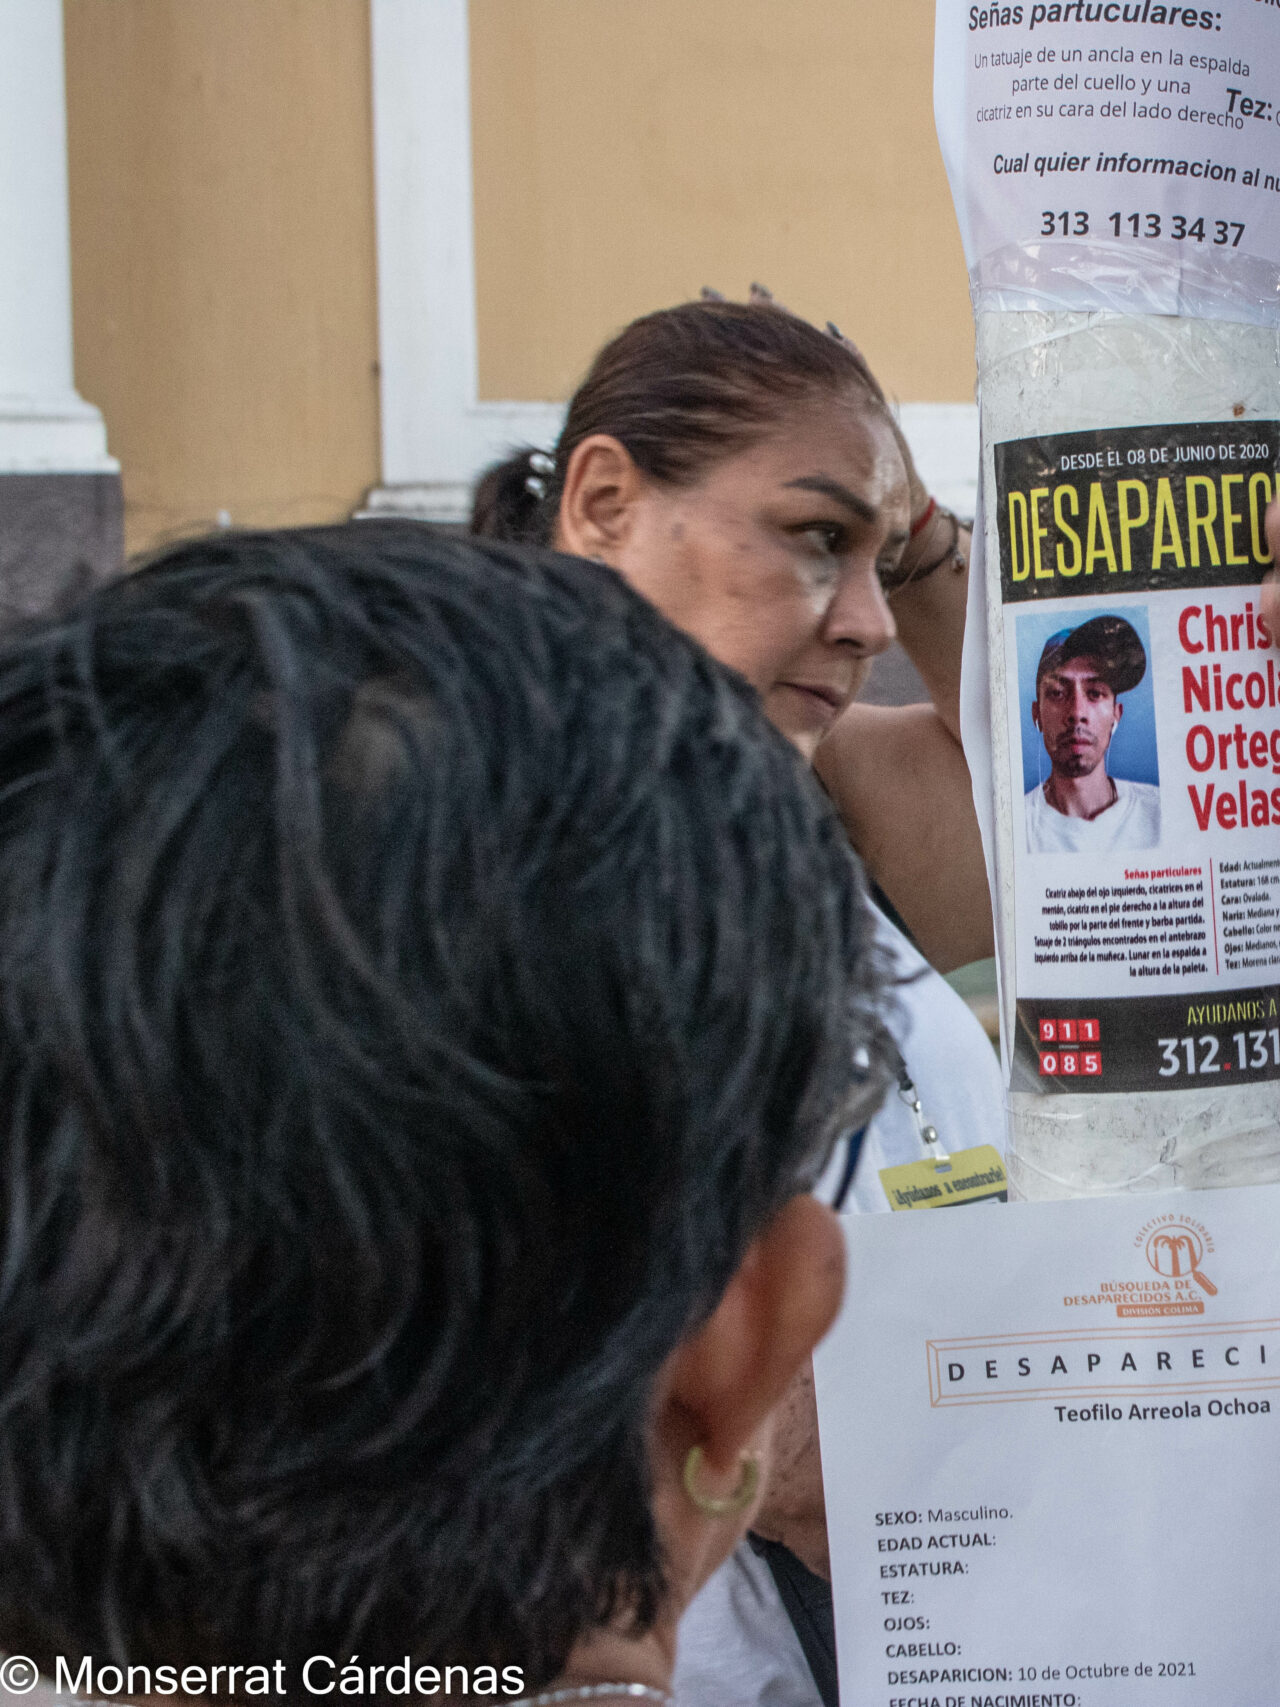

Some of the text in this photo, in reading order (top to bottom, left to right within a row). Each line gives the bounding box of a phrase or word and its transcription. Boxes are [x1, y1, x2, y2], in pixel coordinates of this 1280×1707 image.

[968, 0, 1222, 31] Señas partuculares:
[974, 46, 1250, 77] Un tatuaje de un ancla en la espalda
[1012, 74, 1191, 96] parte del cuello y una
[1226, 88, 1272, 121] Tez:
[976, 101, 1244, 131] cicatriz en su cara del lado derecho
[993, 153, 1029, 175] Cual
[1034, 152, 1090, 177] quier
[1095, 152, 1236, 183] informacion
[1241, 168, 1260, 187] al
[1040, 211, 1246, 247] 313 113 34 37
[1060, 443, 1270, 471] DESDE EL 08 DE JUNIO DE 2020
[1124, 866, 1202, 881] Señas particulares
[1219, 862, 1241, 873] Edad:
[1068, 887, 1085, 900] abajo
[1087, 886, 1097, 897] del
[1098, 887, 1110, 900] ojo
[1111, 884, 1147, 898] izquierdo,
[1149, 882, 1183, 895] cicatrices
[1185, 883, 1194, 892] en
[1196, 881, 1203, 891] el
[1221, 878, 1255, 889] Estatura:
[1067, 897, 1204, 915] cicatriz en el pie derecho a la altura del
[1221, 895, 1241, 905] Cara:
[1069, 921, 1080, 932] por
[1081, 920, 1088, 930] la
[1089, 921, 1107, 932] parte
[1109, 918, 1120, 929] del
[1122, 917, 1144, 928] frente
[1145, 919, 1151, 929] y
[1151, 916, 1174, 927] barba
[1175, 914, 1205, 928] partida.
[1222, 907, 1280, 922] Nariz: Mediana y
[1223, 925, 1255, 937] Cabello:
[1256, 923, 1272, 934] Color
[1034, 931, 1206, 949] Tatuaje de 2 triángulos encontrados en el antebrazo
[1224, 942, 1244, 956] Ojos:
[1060, 947, 1207, 963] arriba de la muñeca. Lunar en la espalda a
[1225, 958, 1240, 970] Tez:
[1242, 957, 1268, 968] Morena
[1129, 962, 1208, 977] la altura de la paleta.
[1187, 1000, 1265, 1027] AYUDANOS
[1269, 998, 1277, 1017] A
[1043, 1022, 1093, 1039] 911
[1043, 1055, 1098, 1073] 085
[1134, 1213, 1175, 1248] COLECTIVO
[1100, 1280, 1192, 1293] BÚSQUEDA DE
[1063, 1291, 1202, 1306] DESAPARECIDOS A.C.
[1122, 1305, 1199, 1315] DIVISIÓN COLIMA
[1054, 1398, 1271, 1423] Teofilo Arreola Ochoa
[875, 1506, 1014, 1526] SEXO: Masculino.
[878, 1533, 996, 1553] EDAD ACTUAL:
[880, 1561, 969, 1579] ESTATURA:
[881, 1590, 915, 1605] TEZ:
[883, 1616, 930, 1632] OJOS:
[885, 1642, 962, 1659] CABELLO:
[887, 1662, 1196, 1686] DESAPARICION: 10 de Octubre de 2021
[889, 1693, 1081, 1707] FECHA DE NACIMIENTO:
